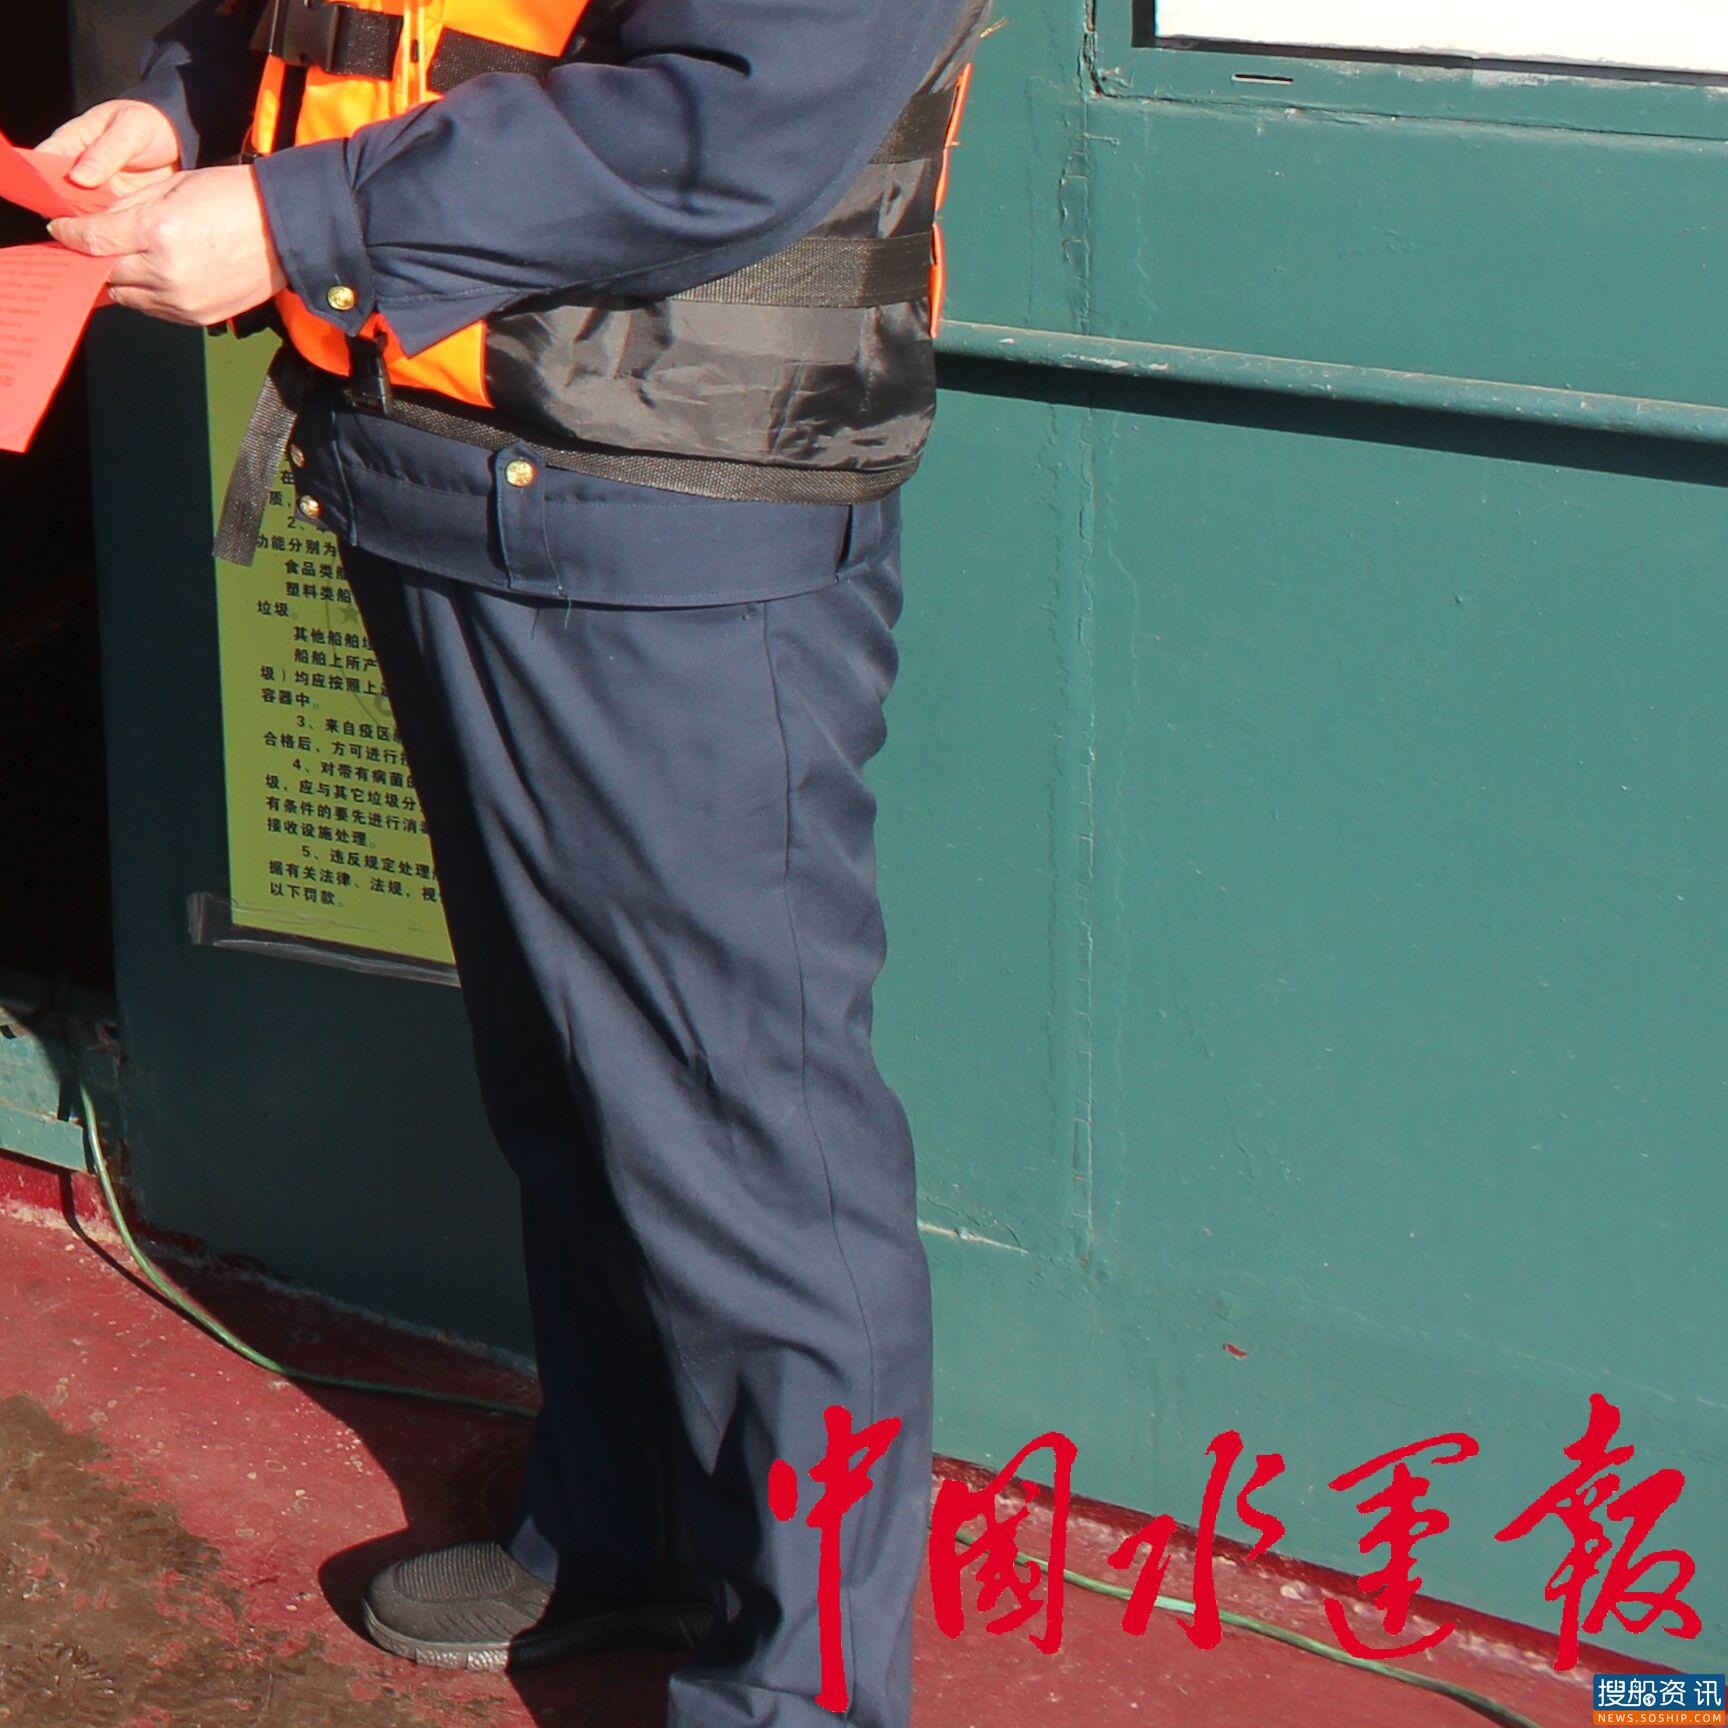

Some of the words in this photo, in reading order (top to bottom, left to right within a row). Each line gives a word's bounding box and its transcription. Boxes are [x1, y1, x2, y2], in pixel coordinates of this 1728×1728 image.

[301, 845, 438, 881] 5、违反规定处理
